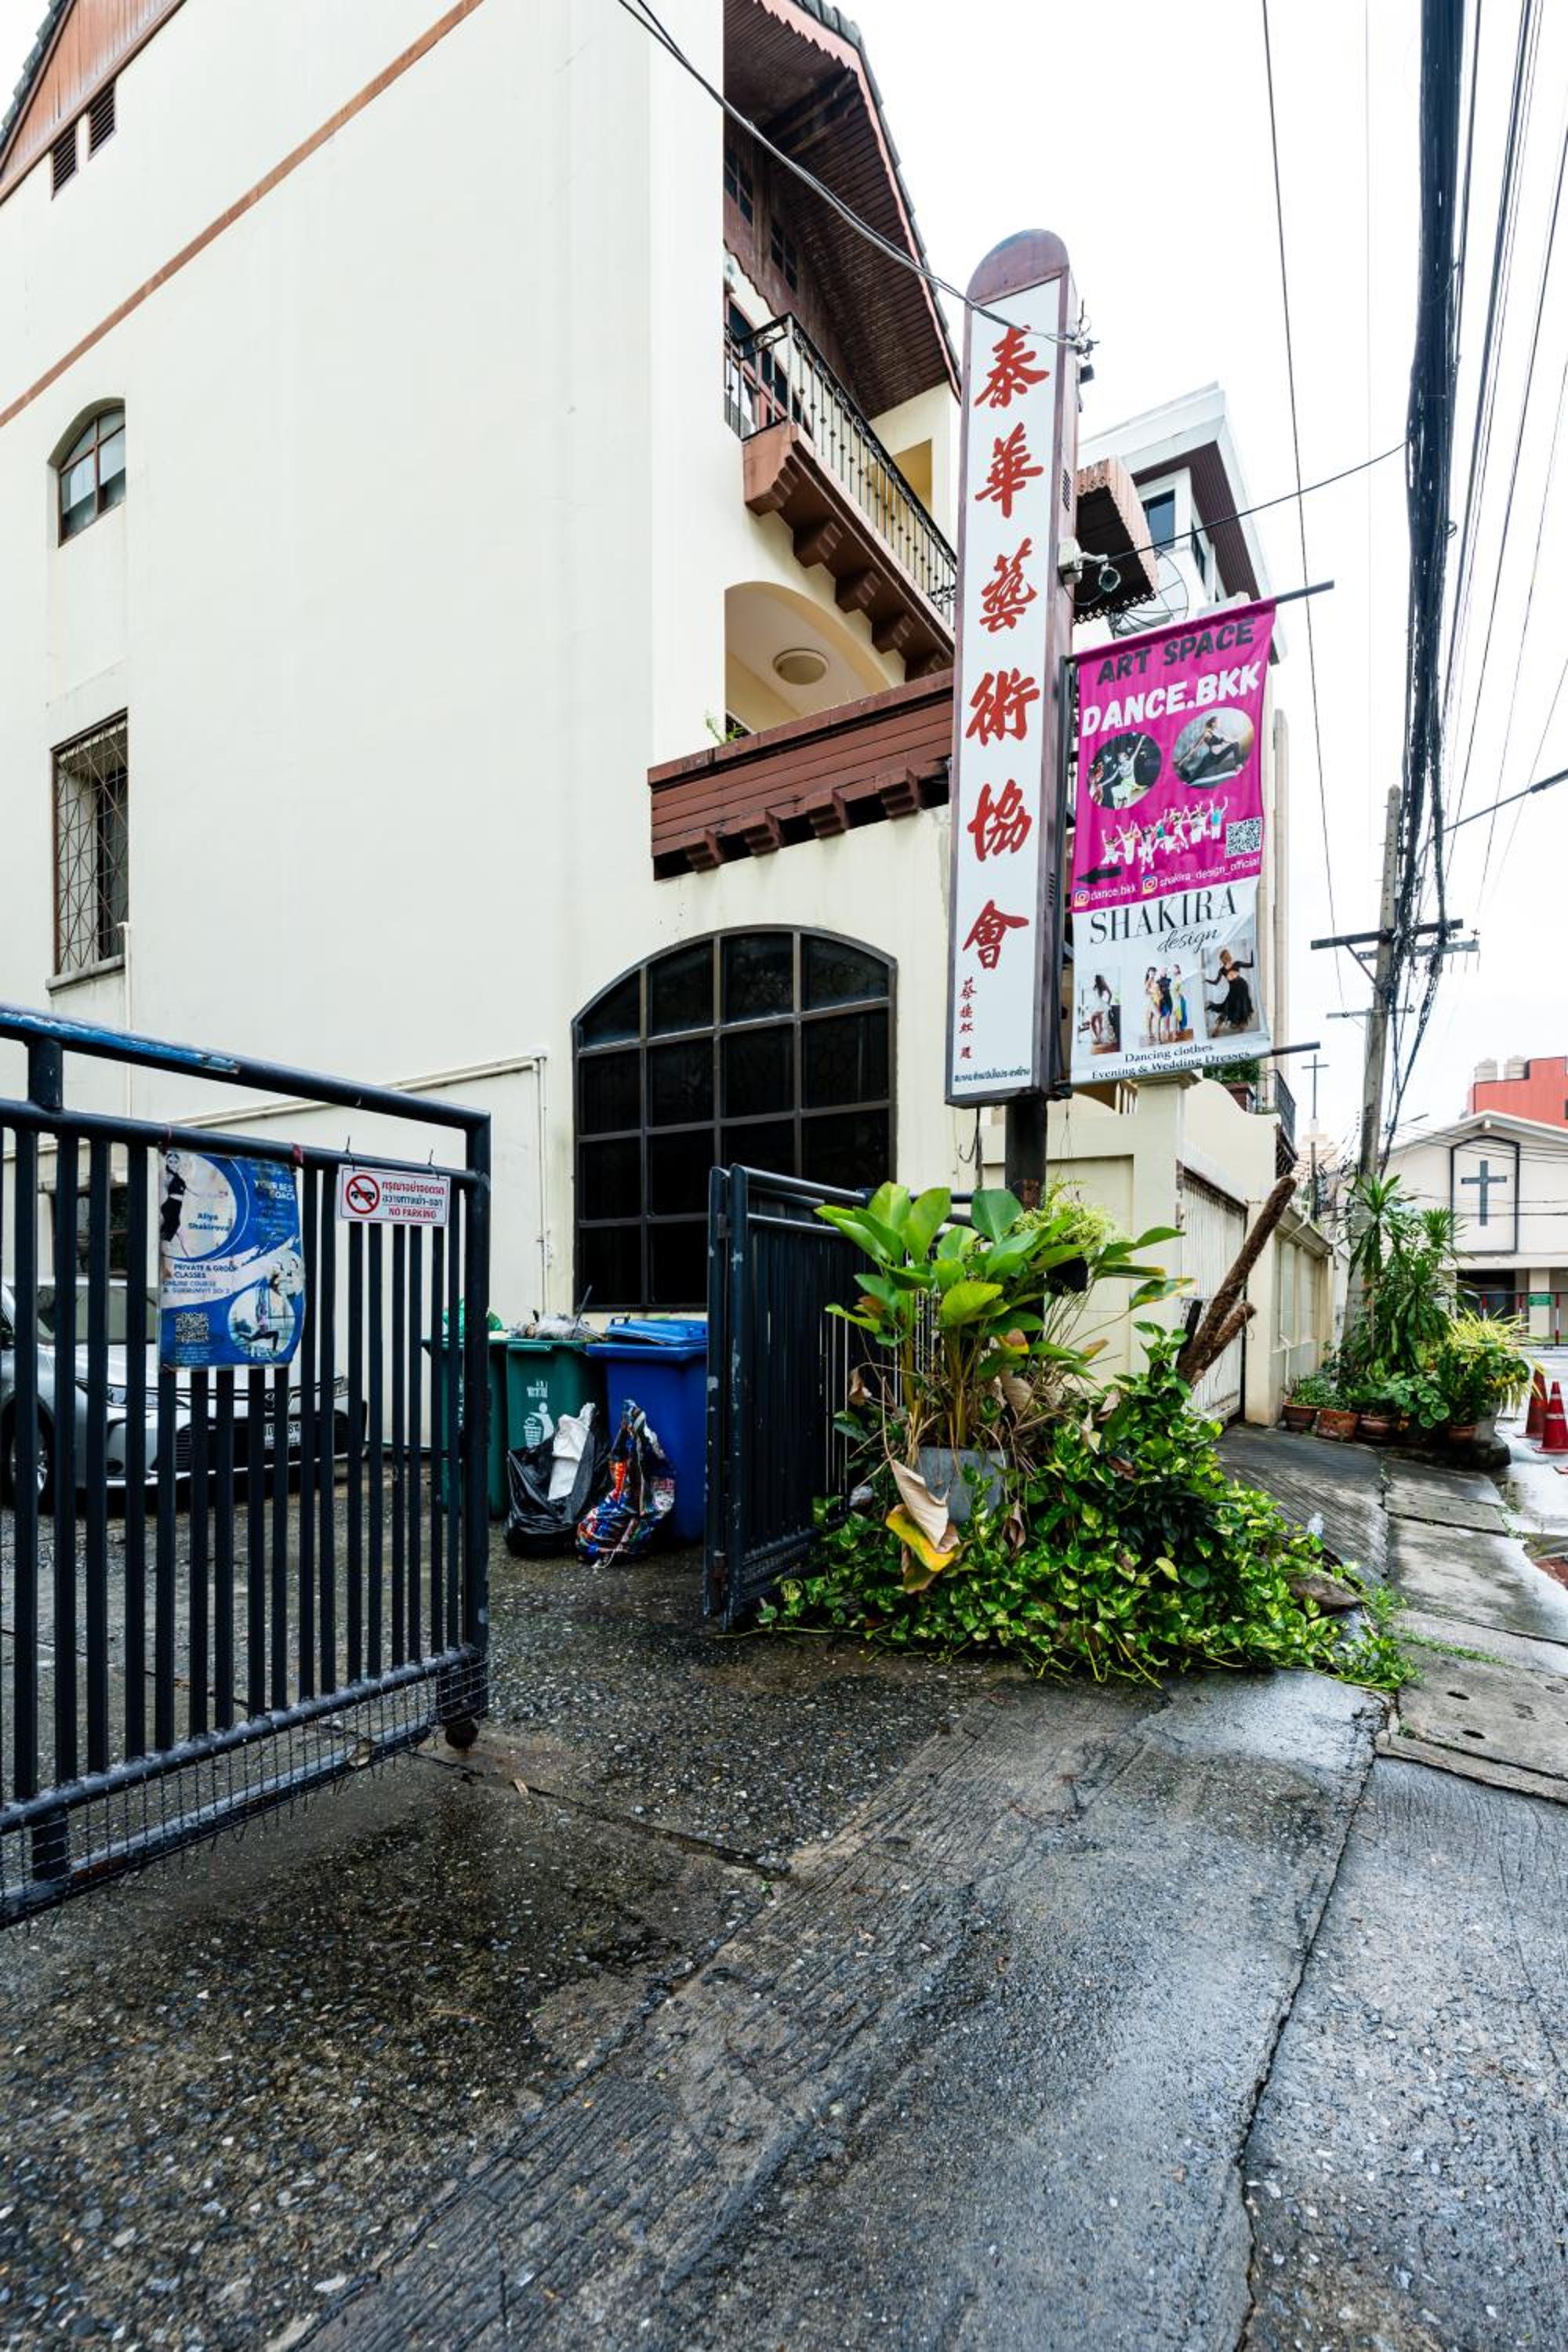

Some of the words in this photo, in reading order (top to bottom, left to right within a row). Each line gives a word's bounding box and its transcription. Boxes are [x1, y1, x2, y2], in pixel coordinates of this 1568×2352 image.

[1098, 648, 1151, 685] ART
[1163, 618, 1256, 666] SPACE
[1081, 661, 1261, 737] DANCE.BKK
[1091, 884, 1137, 901] dance.bkk
[1159, 857, 1261, 887] shakira_design_official
[1091, 886, 1238, 945] SHAKIRA
[1156, 927, 1218, 954] design
[1092, 1066, 1136, 1080] Evening
[1138, 1064, 1148, 1073] &
[1152, 1056, 1203, 1071] Wedding
[1205, 1051, 1250, 1064] Dresses
[1125, 1048, 1171, 1062] Dancing
[1174, 1044, 1214, 1056] clothes
[388, 1207, 401, 1217] NO
[402, 1208, 437, 1219] PARKING
